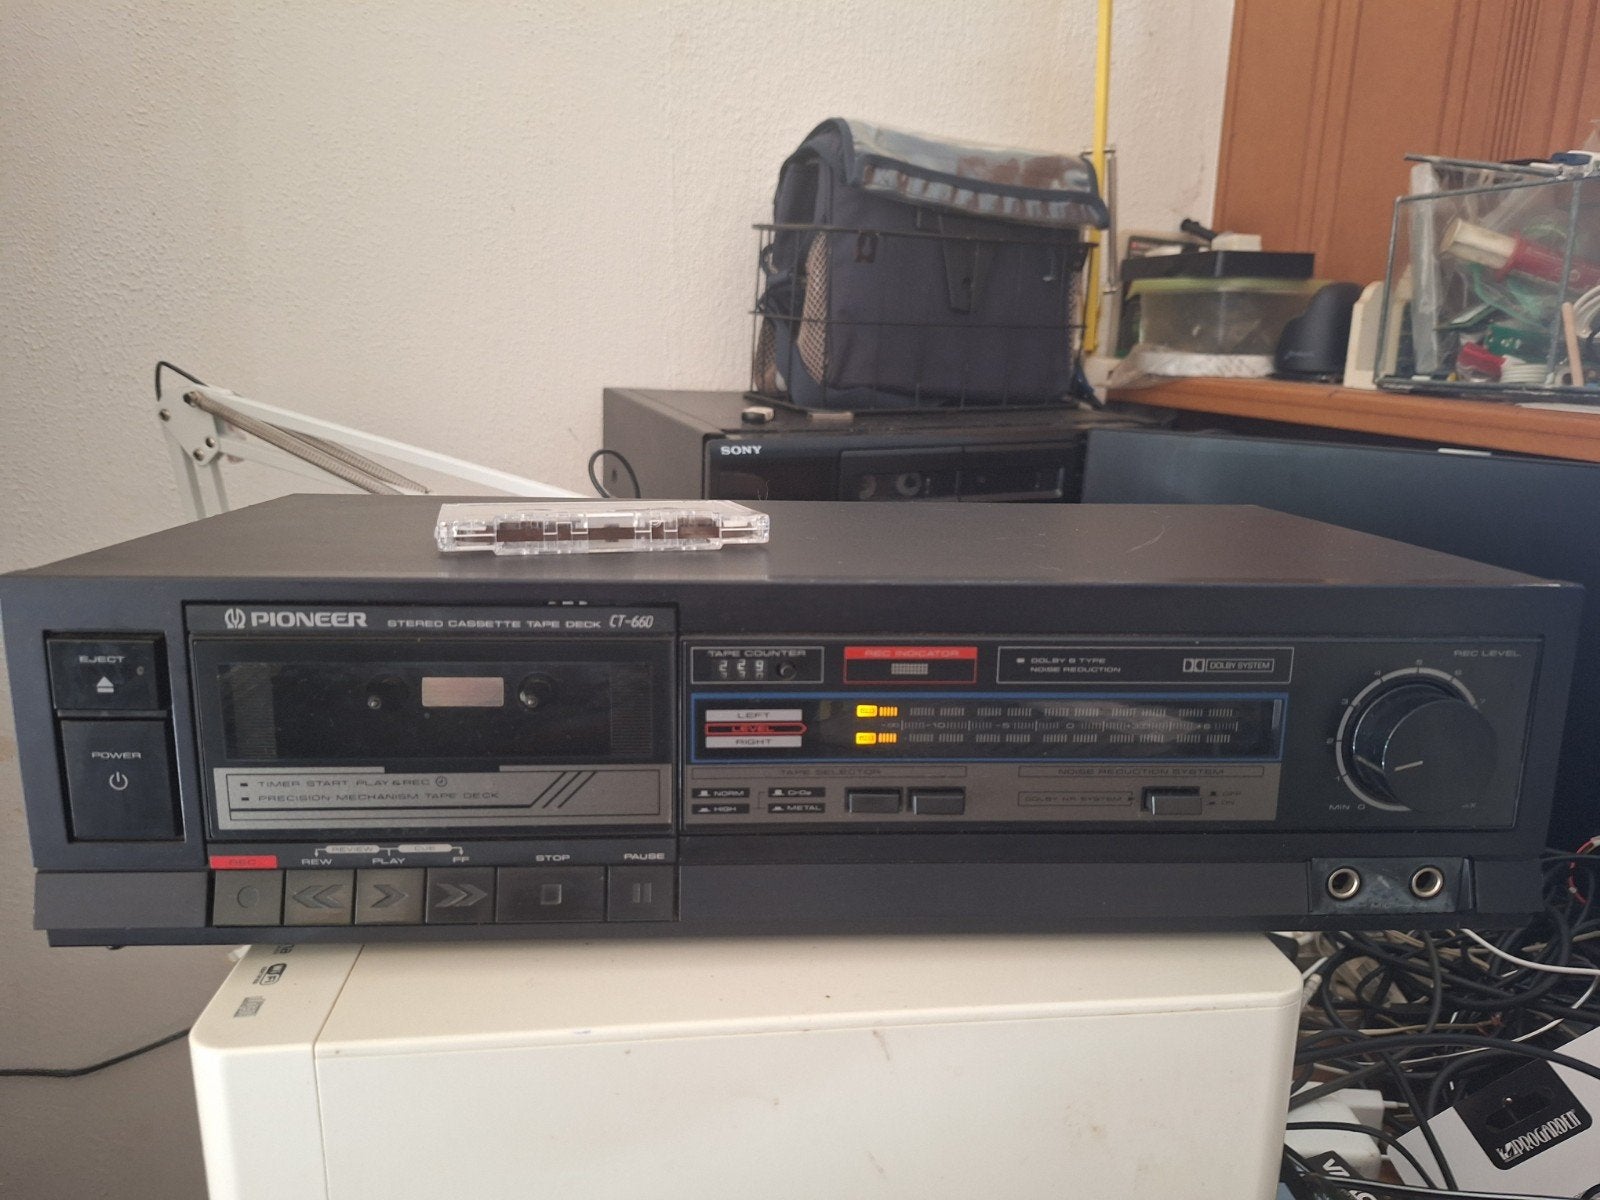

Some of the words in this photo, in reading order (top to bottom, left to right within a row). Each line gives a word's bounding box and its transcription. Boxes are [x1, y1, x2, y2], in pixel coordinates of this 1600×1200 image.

[720, 445, 762, 456] SONY
[251, 611, 369, 628] PIONEER
[387, 619, 444, 628] STEREO
[448, 619, 523, 628] CASSETTE
[527, 620, 561, 628] TAPE
[565, 620, 601, 628] DECK
[609, 614, 655, 630] CT-660
[707, 650, 741, 658] TAPE
[744, 649, 807, 658] COUNTER
[894, 649, 960, 658] INDICATOR
[1453, 649, 1480, 658] REC
[1481, 649, 1522, 658] LEVEL
[79, 654, 126, 664] EJECT
[1062, 666, 1122, 674] REDUCTION
[1209, 660, 1237, 671] DOLBY
[1238, 660, 1271, 671] SYSTEM
[737, 711, 770, 720] LEFT
[731, 724, 775, 733] LEVEL
[735, 738, 772, 746] RIGHT
[91, 751, 143, 760] POWER
[1057, 768, 1096, 776] NOISE
[1098, 767, 1169, 776] REDUCTION
[1171, 767, 1225, 776] SYSTEM
[257, 780, 301, 788] TIMER
[258, 794, 332, 802] PRECISION
[335, 793, 419, 802] MECHANISM
[424, 792, 458, 800] TAPE
[462, 792, 500, 800] DECK
[786, 804, 822, 812] METAL
[331, 846, 375, 854] REVIEW
[413, 845, 437, 853] CUE
[371, 856, 407, 866] PLAY
[452, 856, 471, 864] FF
[535, 854, 571, 863] STOP
[624, 852, 666, 862] PAUSE
[227, 858, 257, 867] REC
[301, 858, 334, 867] REW
